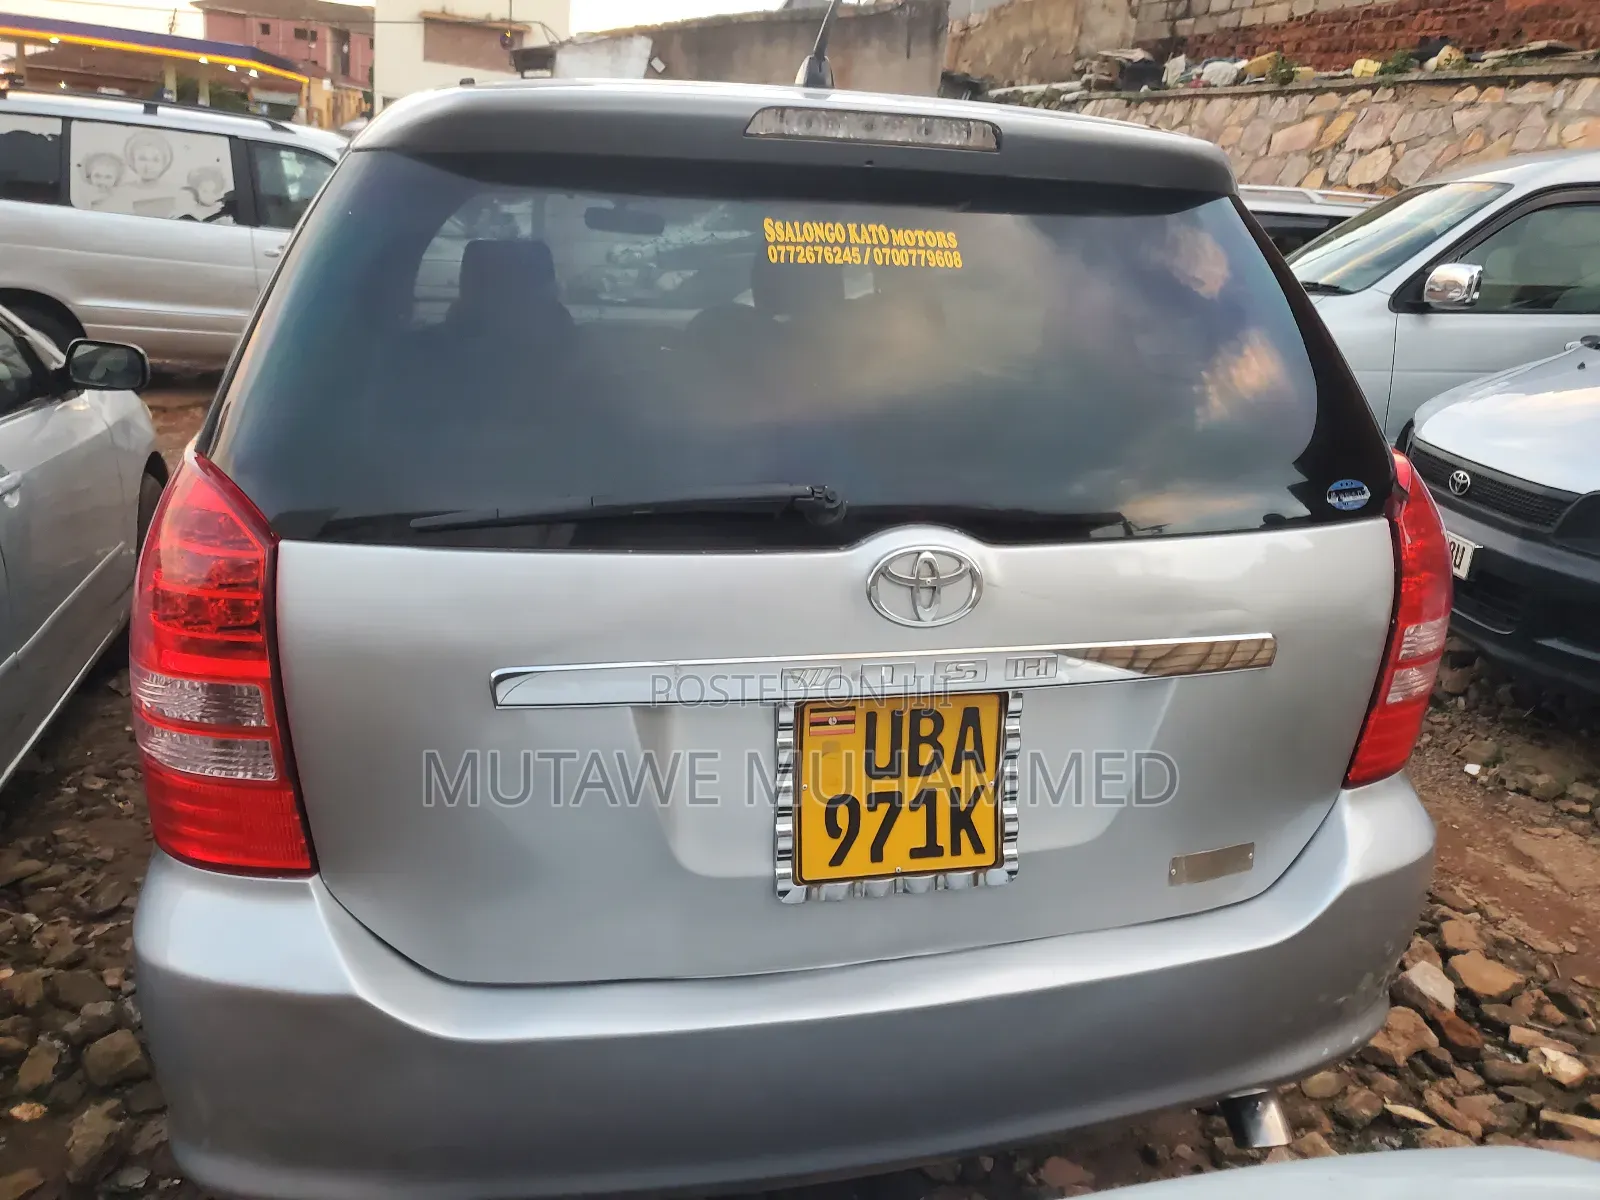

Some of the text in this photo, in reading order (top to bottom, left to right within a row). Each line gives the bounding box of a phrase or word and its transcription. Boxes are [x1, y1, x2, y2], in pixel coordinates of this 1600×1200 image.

[847, 223, 889, 245] KATO
[890, 229, 958, 249] MOTORS
[781, 653, 1058, 692] WISH
[864, 706, 986, 779] UBA
[824, 784, 986, 868] 971K
